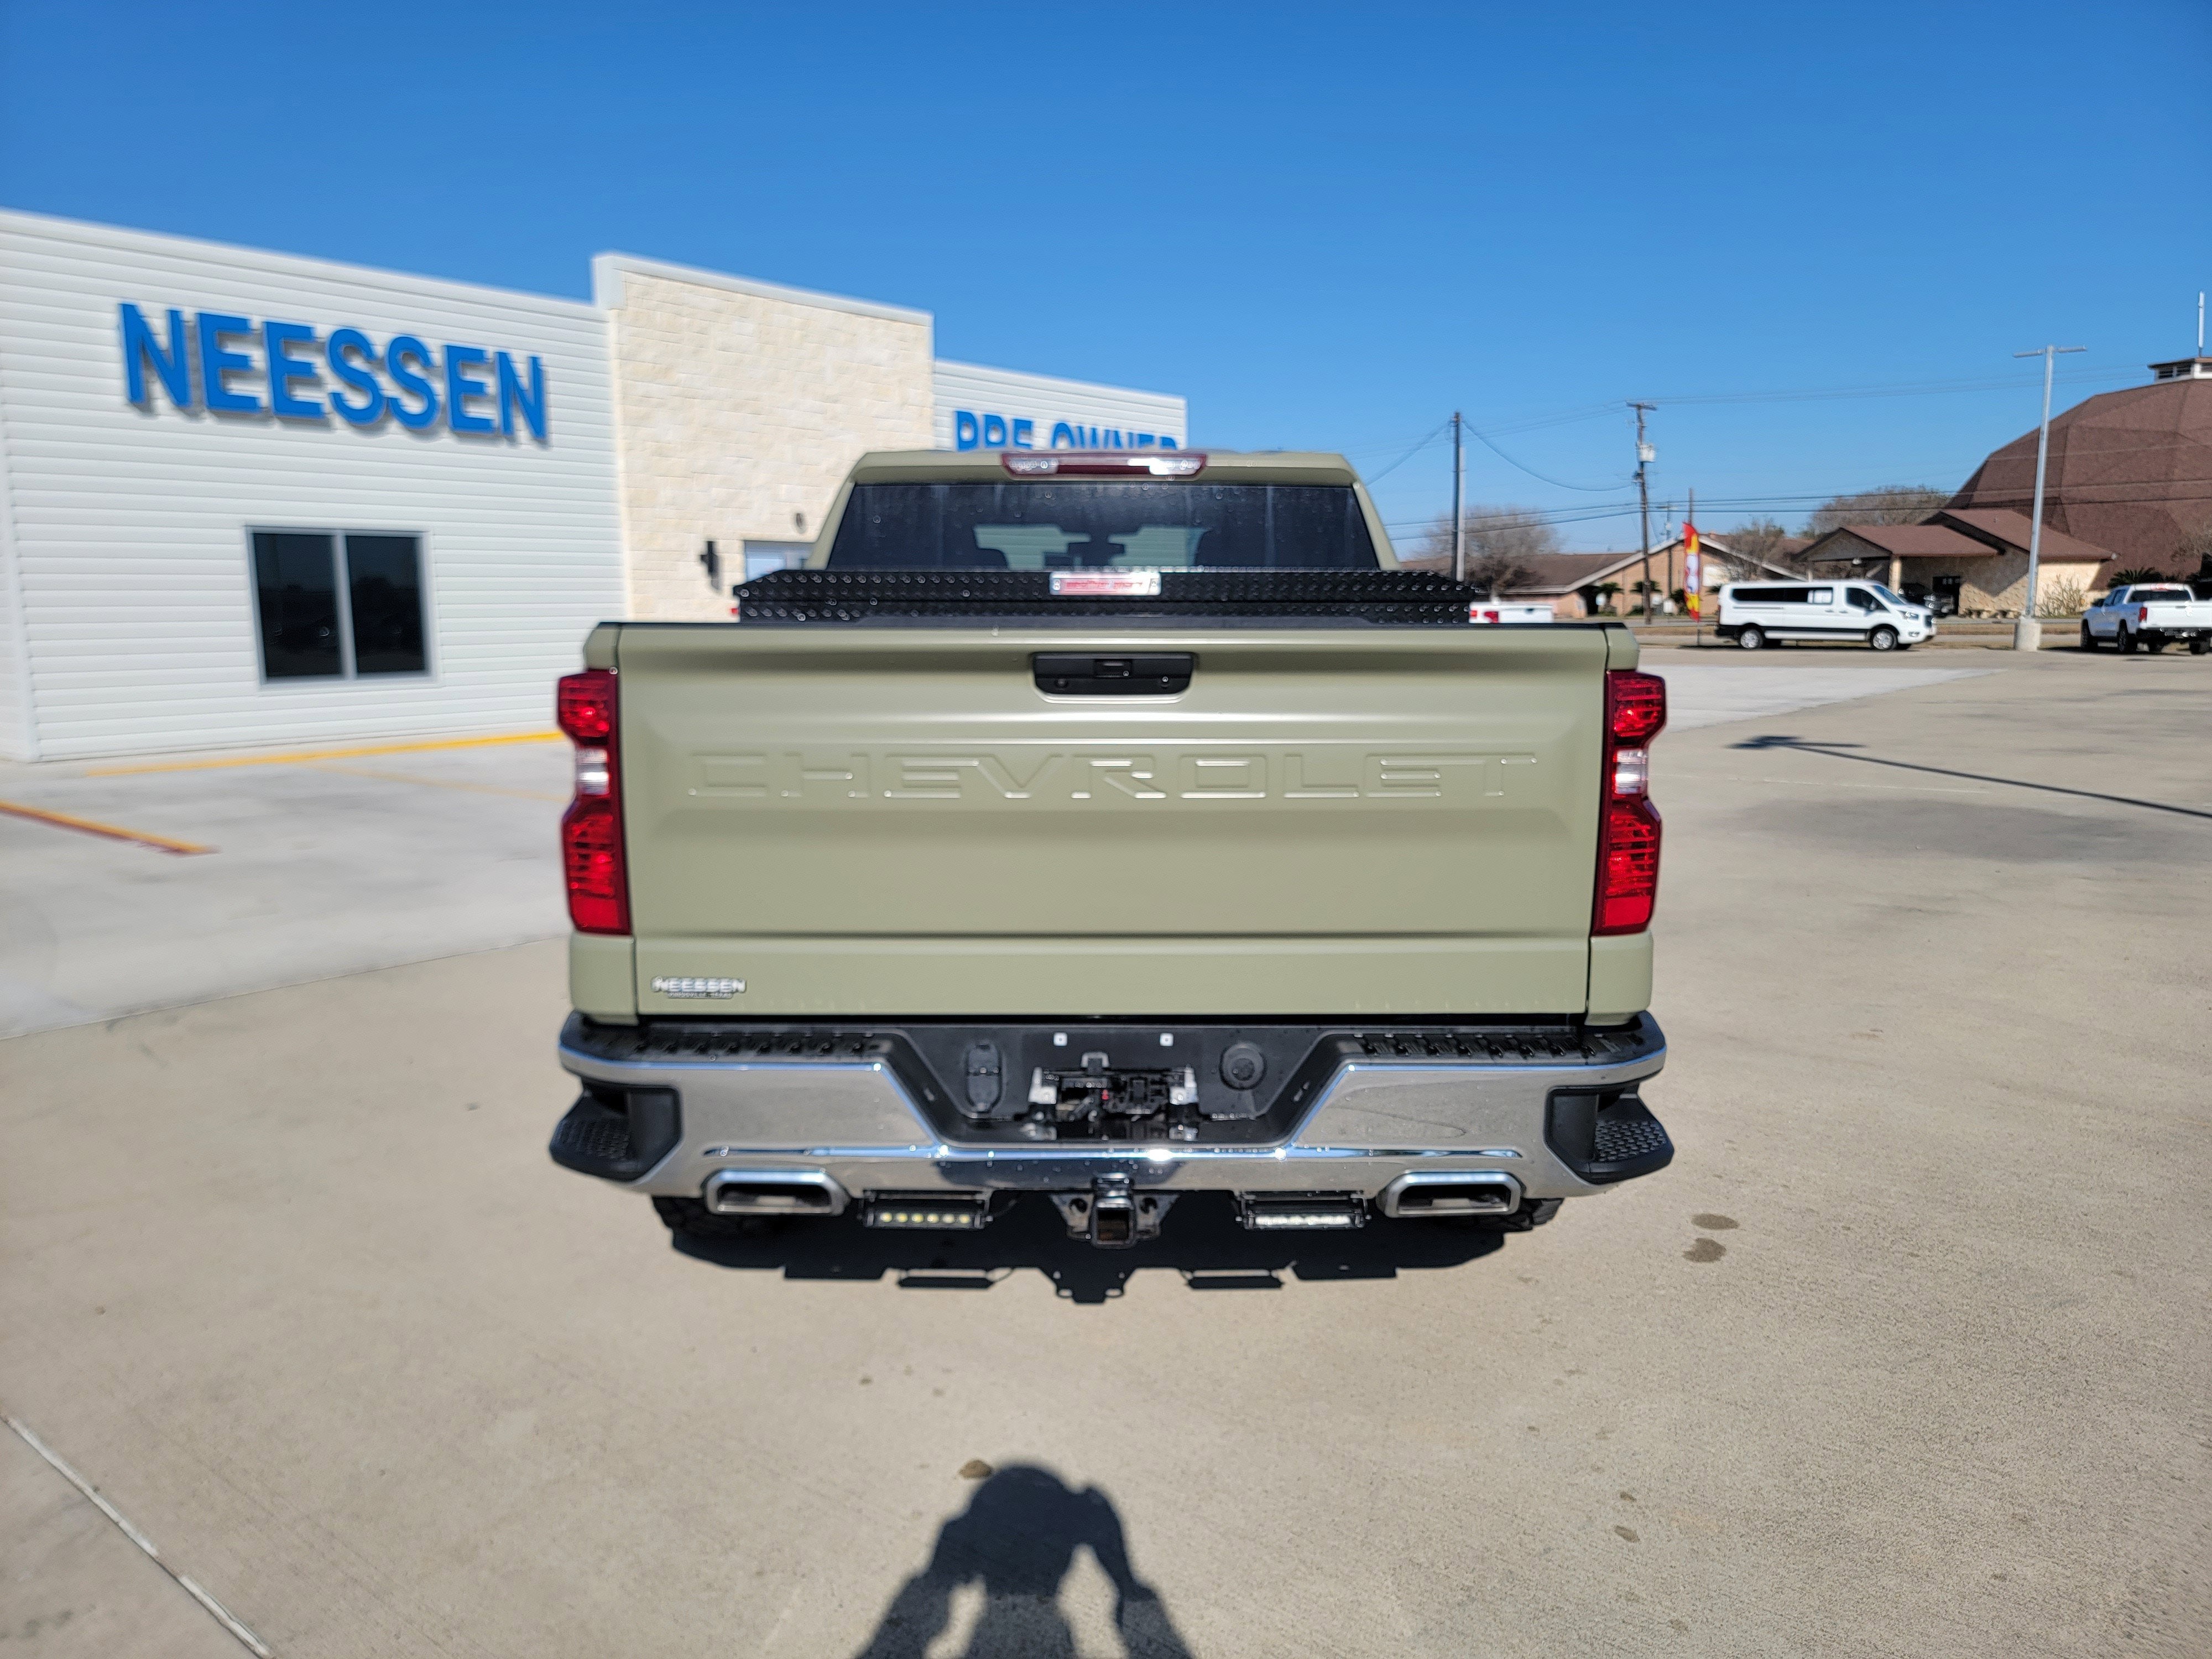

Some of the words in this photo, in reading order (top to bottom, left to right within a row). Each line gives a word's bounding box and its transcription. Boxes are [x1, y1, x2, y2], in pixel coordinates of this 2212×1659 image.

[117, 302, 549, 440] NEESSEN
[688, 752, 1537, 798] CHEVROLET
[651, 976, 746, 992] NEESSEN
